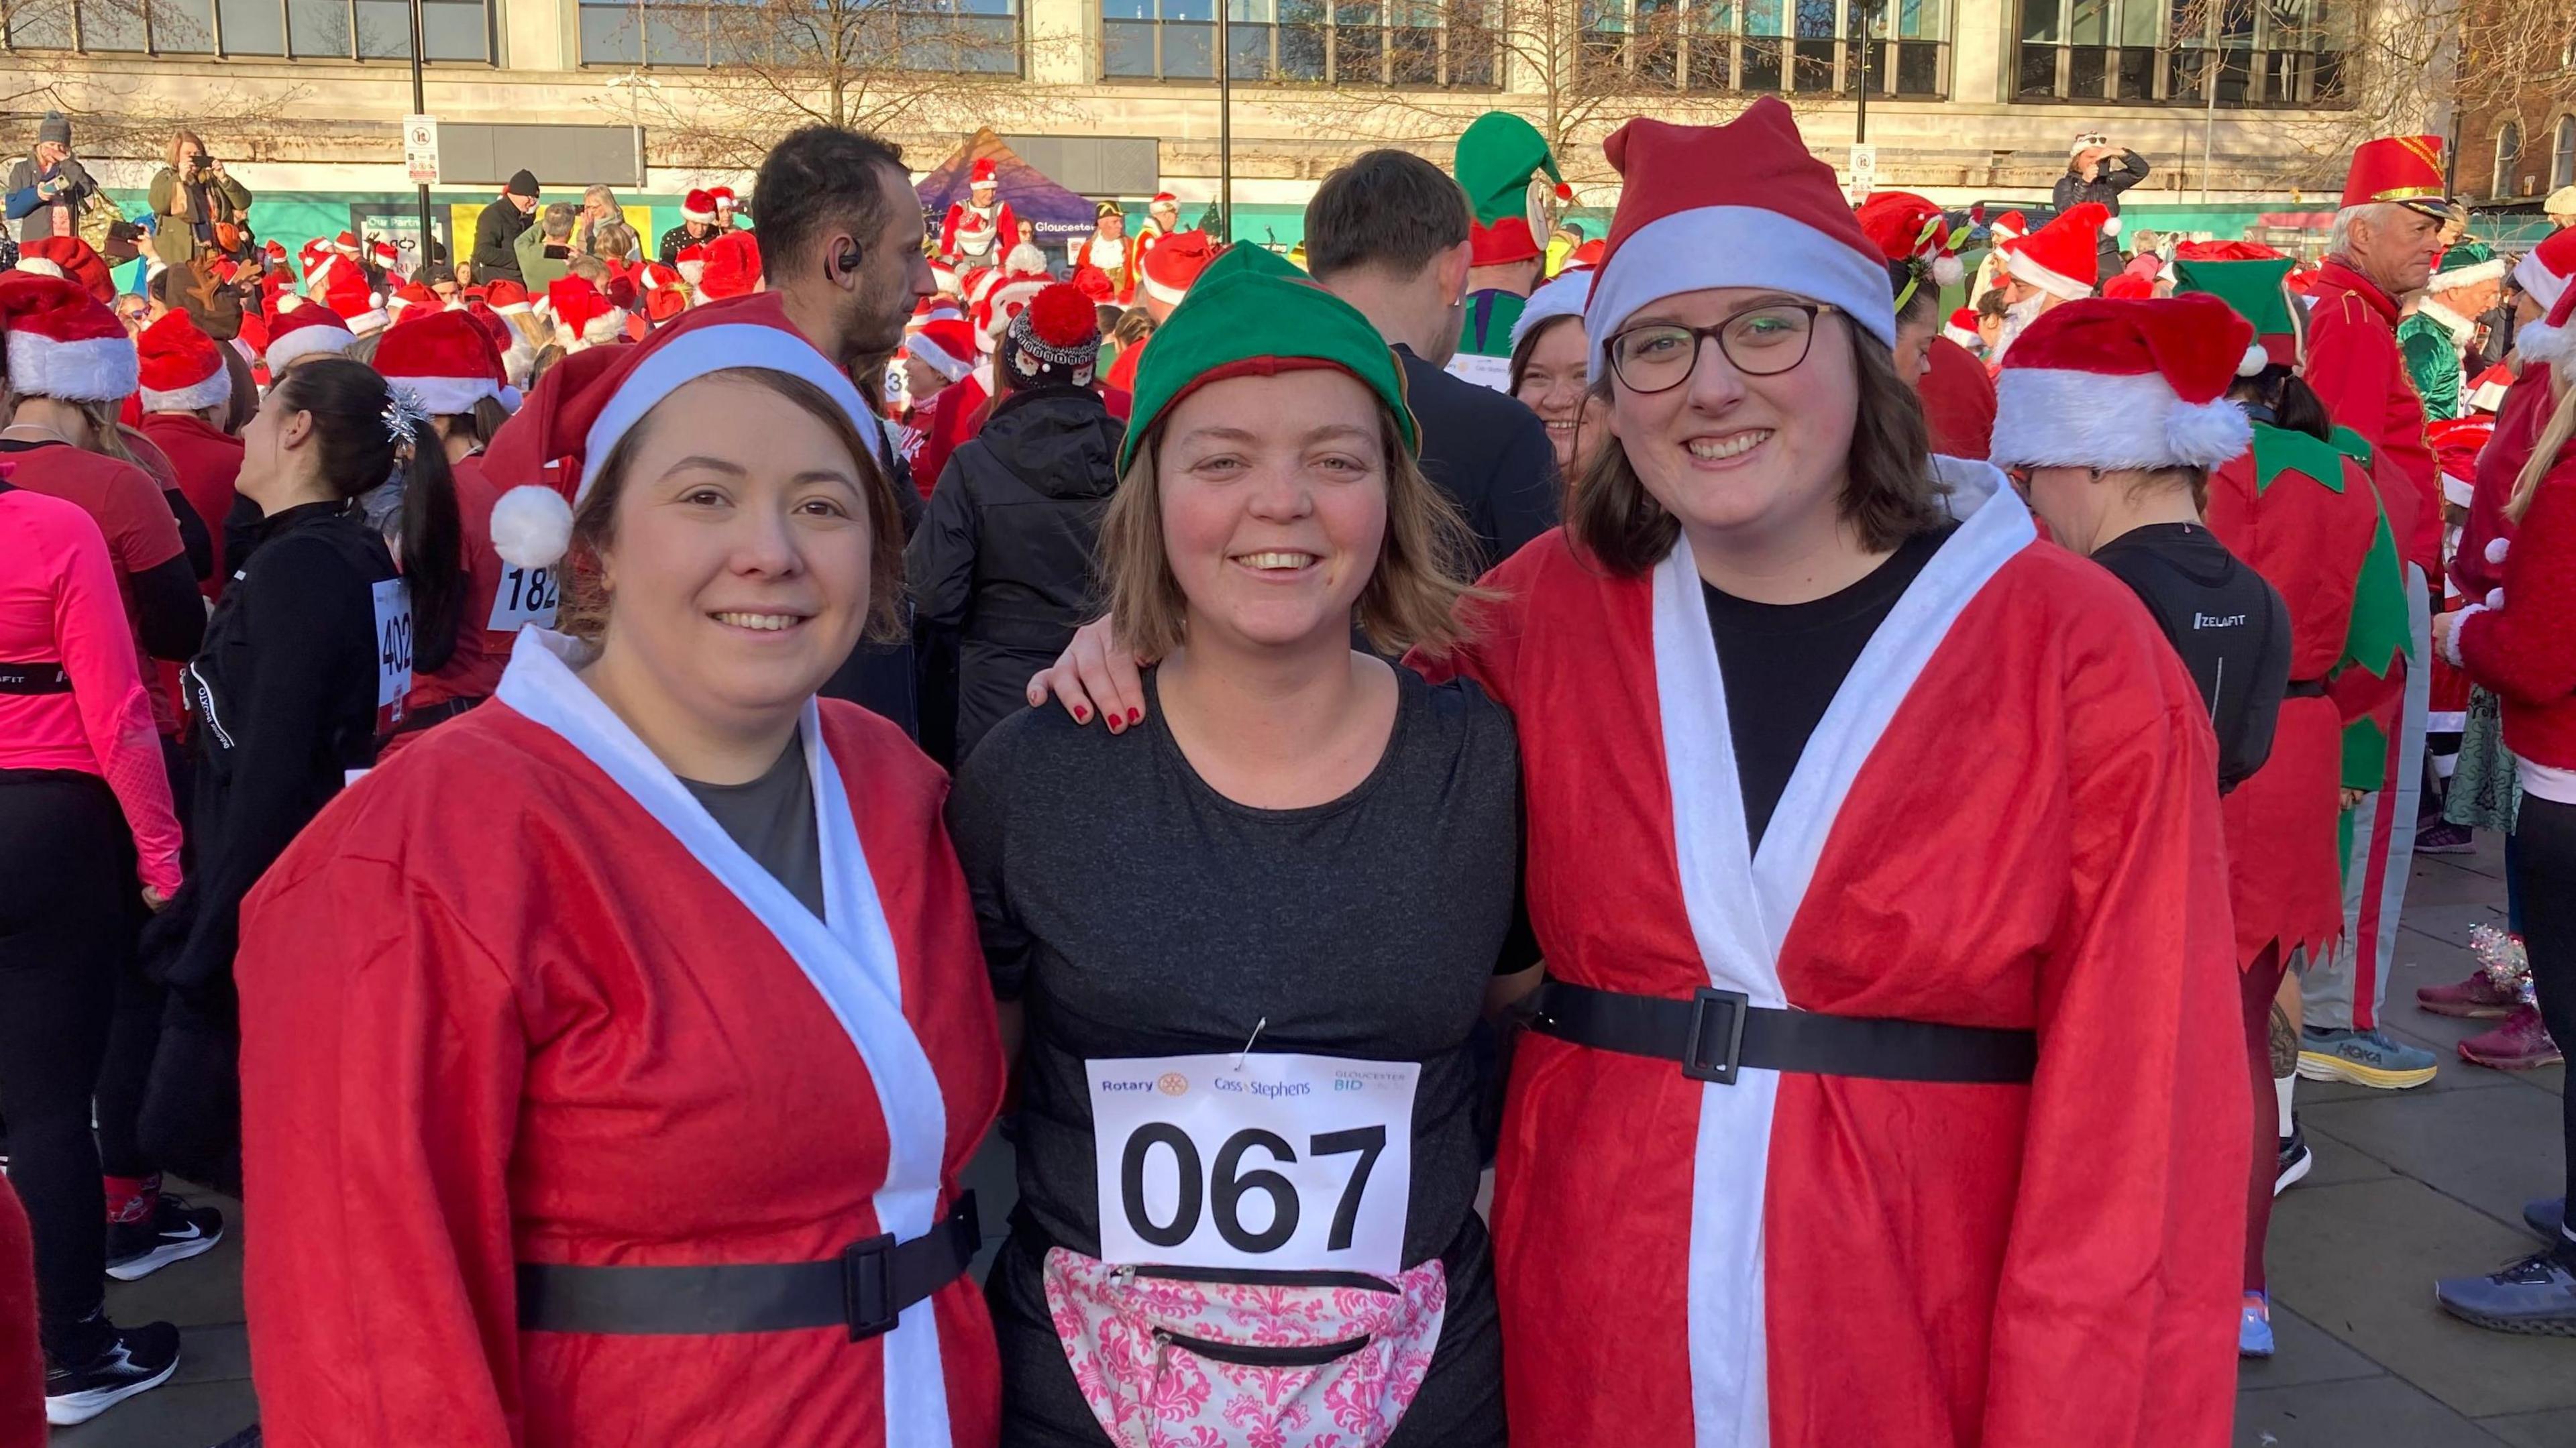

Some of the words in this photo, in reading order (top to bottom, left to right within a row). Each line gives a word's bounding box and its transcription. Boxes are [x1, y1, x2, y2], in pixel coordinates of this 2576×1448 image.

[368, 217, 388, 227] Our
[390, 217, 435, 227] Partns
[508, 563, 557, 612] 182
[2202, 614, 2246, 627] ZELAFIT
[382, 613, 411, 675] 402
[0, 675, 25, 683] FIT
[198, 687, 213, 724] INOXTO
[2337, 1042, 2382, 1066] HOKA
[1102, 1080, 1153, 1093] Rotary
[1214, 1077, 1243, 1092] Cass
[1250, 1080, 1311, 1100] Stephens
[1334, 1079, 1363, 1091] BID
[1120, 1121, 1387, 1254] 067
